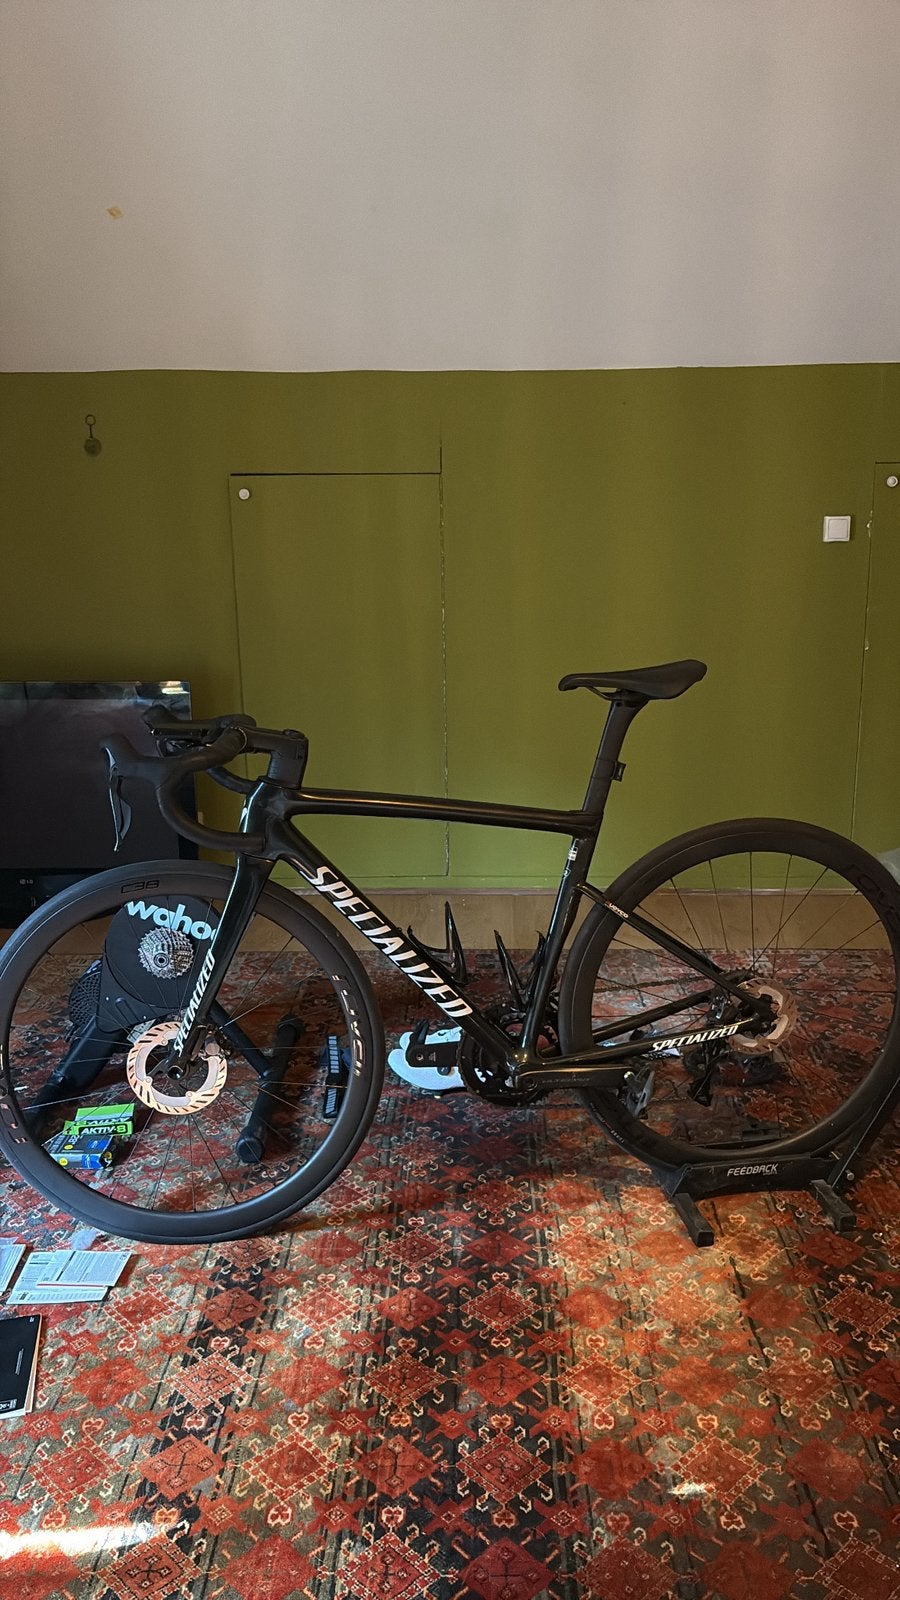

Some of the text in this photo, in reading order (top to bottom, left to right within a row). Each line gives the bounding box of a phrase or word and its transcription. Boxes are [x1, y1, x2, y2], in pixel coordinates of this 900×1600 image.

[124, 900, 217, 941] waho
[304, 866, 473, 1018] SPECIALIZED
[173, 948, 216, 1058] SPECIALIZED
[650, 1024, 739, 1052] SPECIALIZED
[726, 1163, 779, 1177] FEEDBACK
